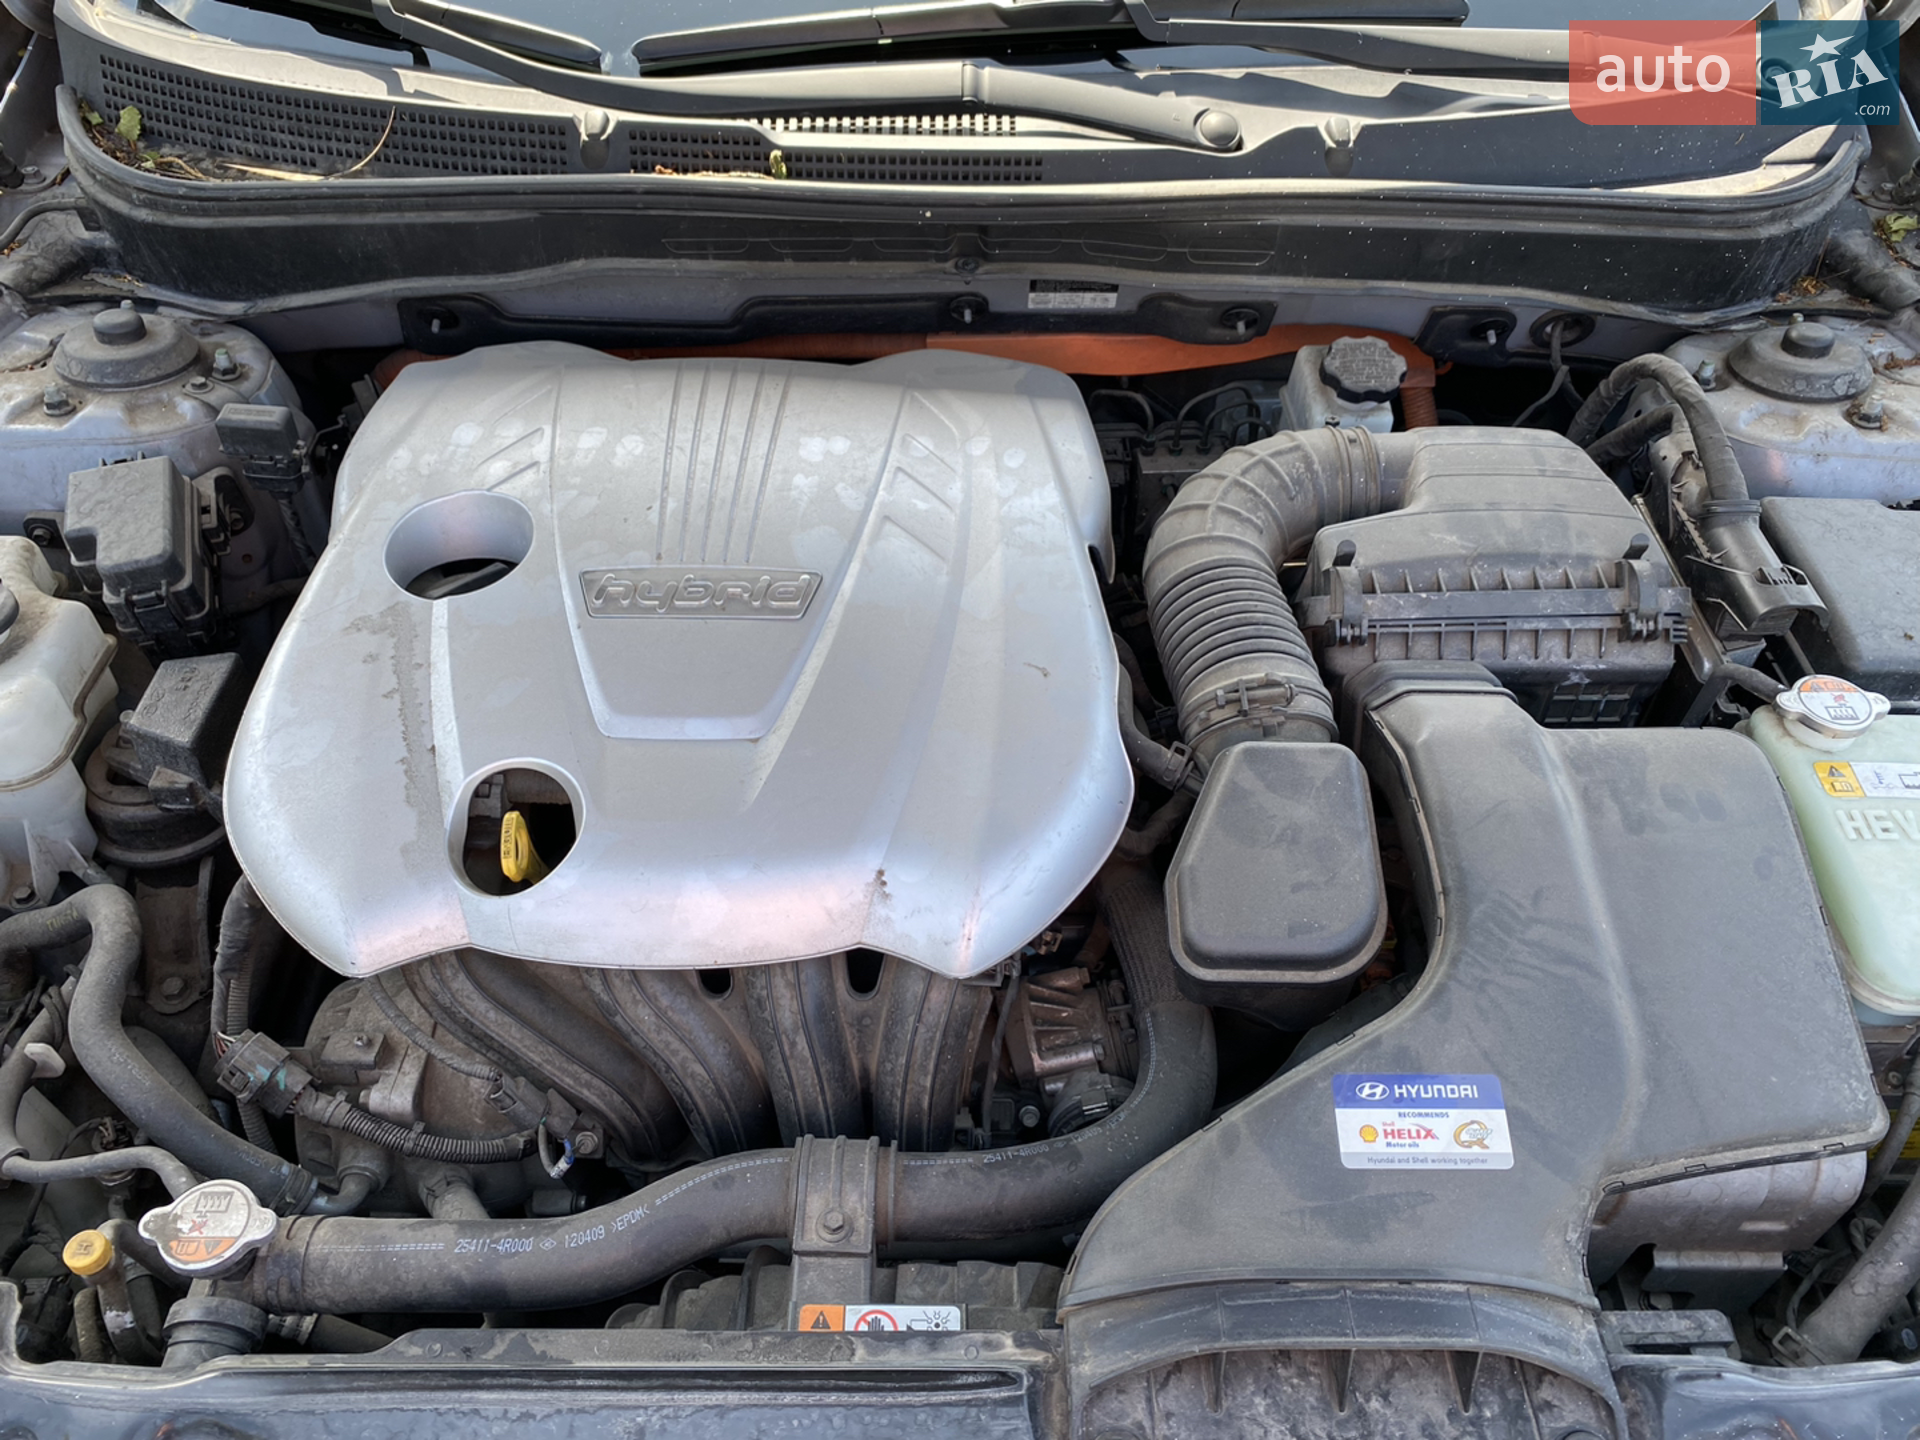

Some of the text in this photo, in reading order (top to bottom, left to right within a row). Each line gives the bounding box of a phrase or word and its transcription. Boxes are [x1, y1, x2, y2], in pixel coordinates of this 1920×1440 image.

[591, 573, 811, 613] hybrid
[1394, 1084, 1479, 1099] HYUNDAI
[1382, 1128, 1436, 1140] HELIX
[1367, 1156, 1488, 1165] Hyundai and Shell working together
[454, 1236, 534, 1253] 25411-4R000
[564, 1225, 606, 1248] 120409
